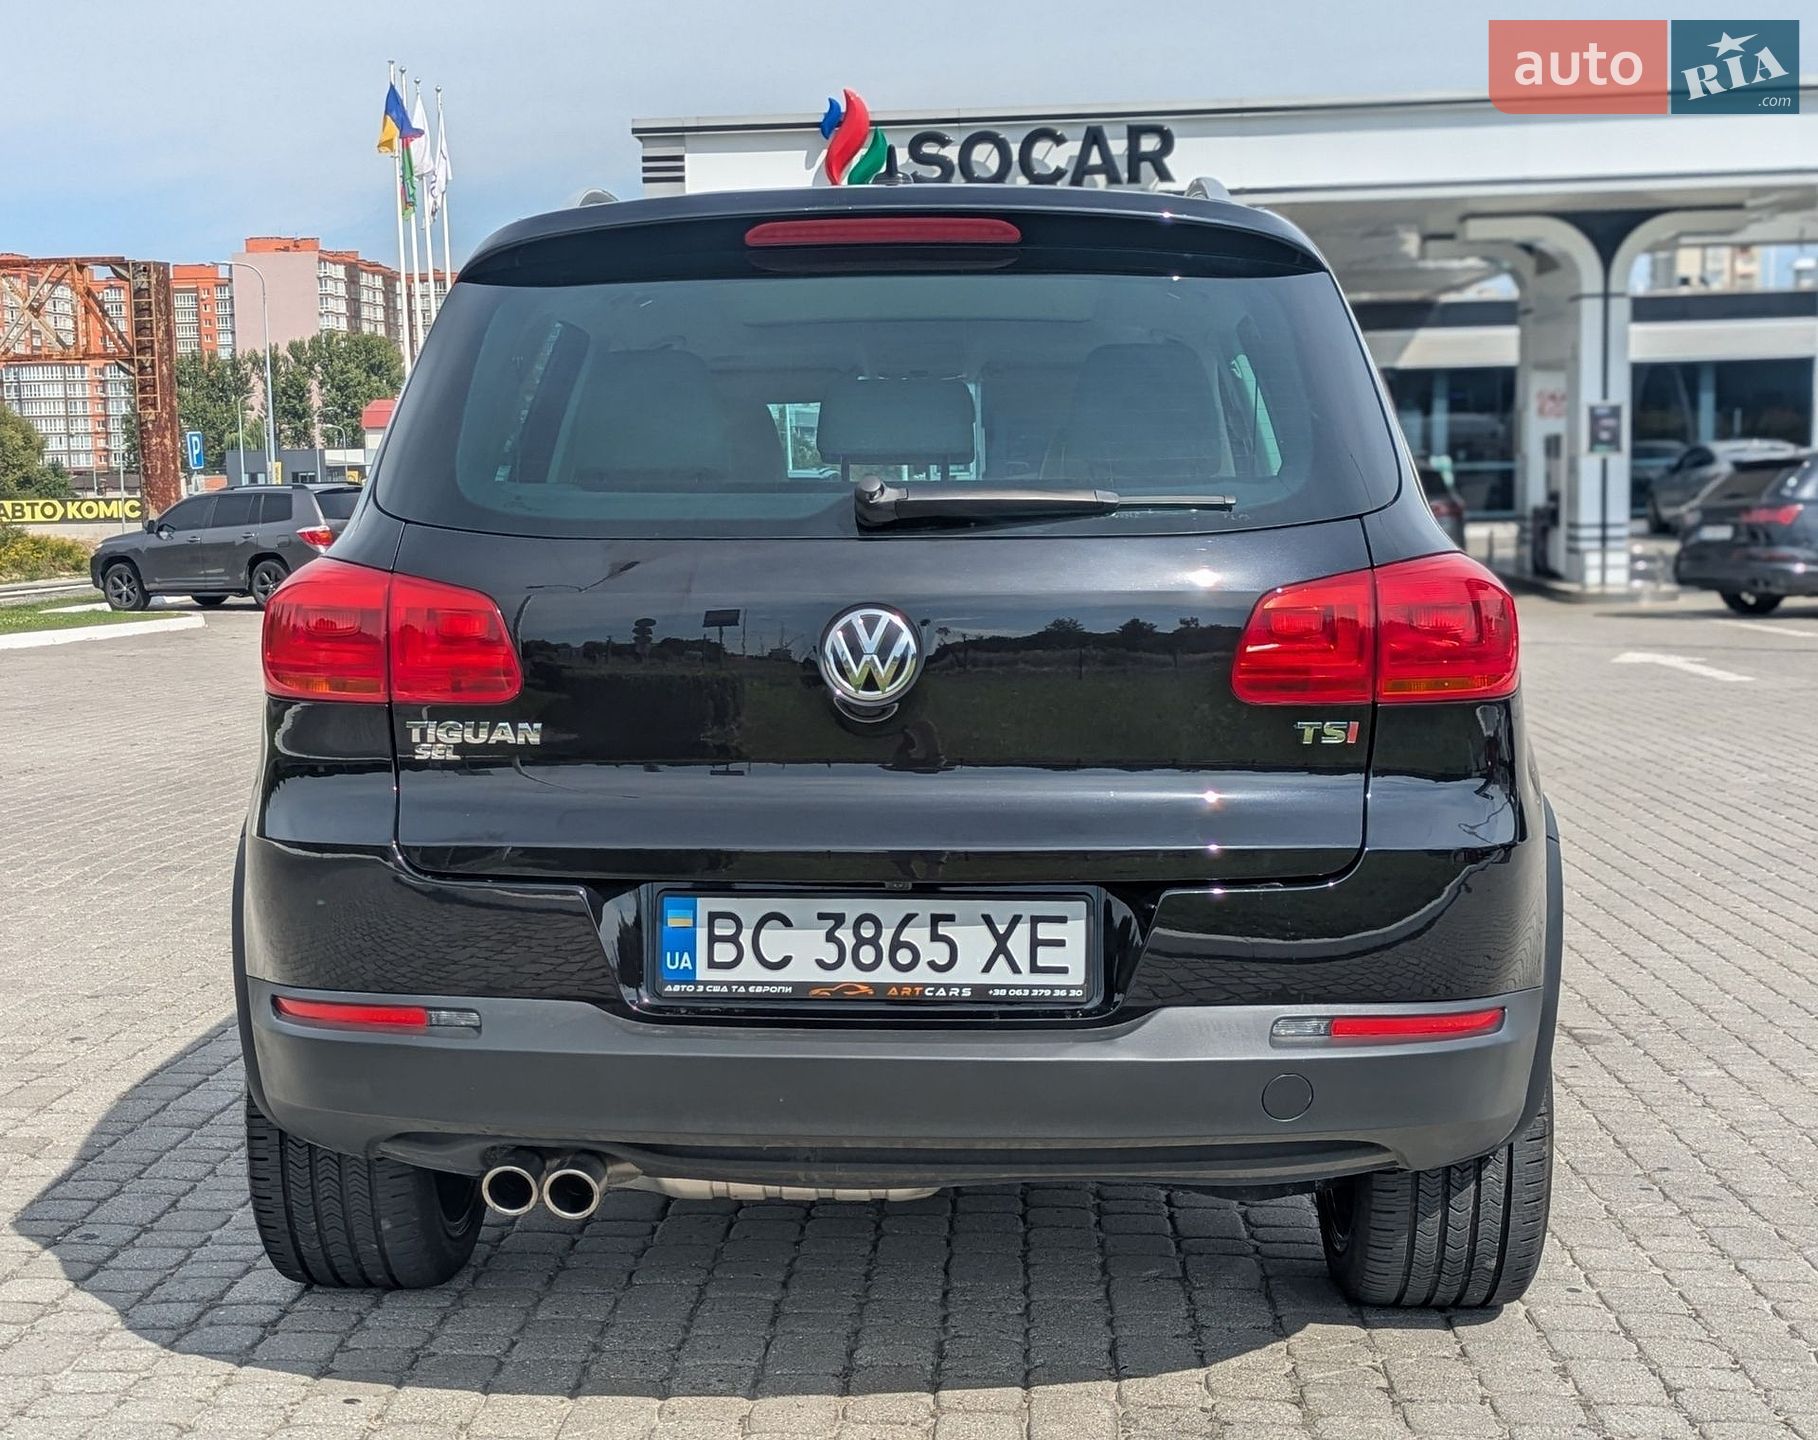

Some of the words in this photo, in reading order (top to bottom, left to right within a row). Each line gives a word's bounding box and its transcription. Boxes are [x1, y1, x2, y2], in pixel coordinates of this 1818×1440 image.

[907, 124, 1176, 185] SOCAR
[405, 721, 543, 745] TIGUAN
[1297, 721, 1360, 744] TSI
[414, 743, 461, 760] SEL
[706, 910, 795, 971] BC
[813, 911, 959, 973] 3865
[980, 912, 1070, 975] XE
[665, 951, 693, 971] UA
[664, 984, 695, 992] АВТО
[706, 984, 729, 993] США
[731, 985, 746, 993] ТА
[748, 985, 793, 993] ЄВРОПИ
[887, 986, 972, 997] ARTCARS
[988, 988, 1006, 996] +38
[1008, 988, 1029, 996] 063
[1031, 988, 1051, 996] 379
[1053, 988, 1067, 997] 36
[1069, 988, 1083, 997] 30
